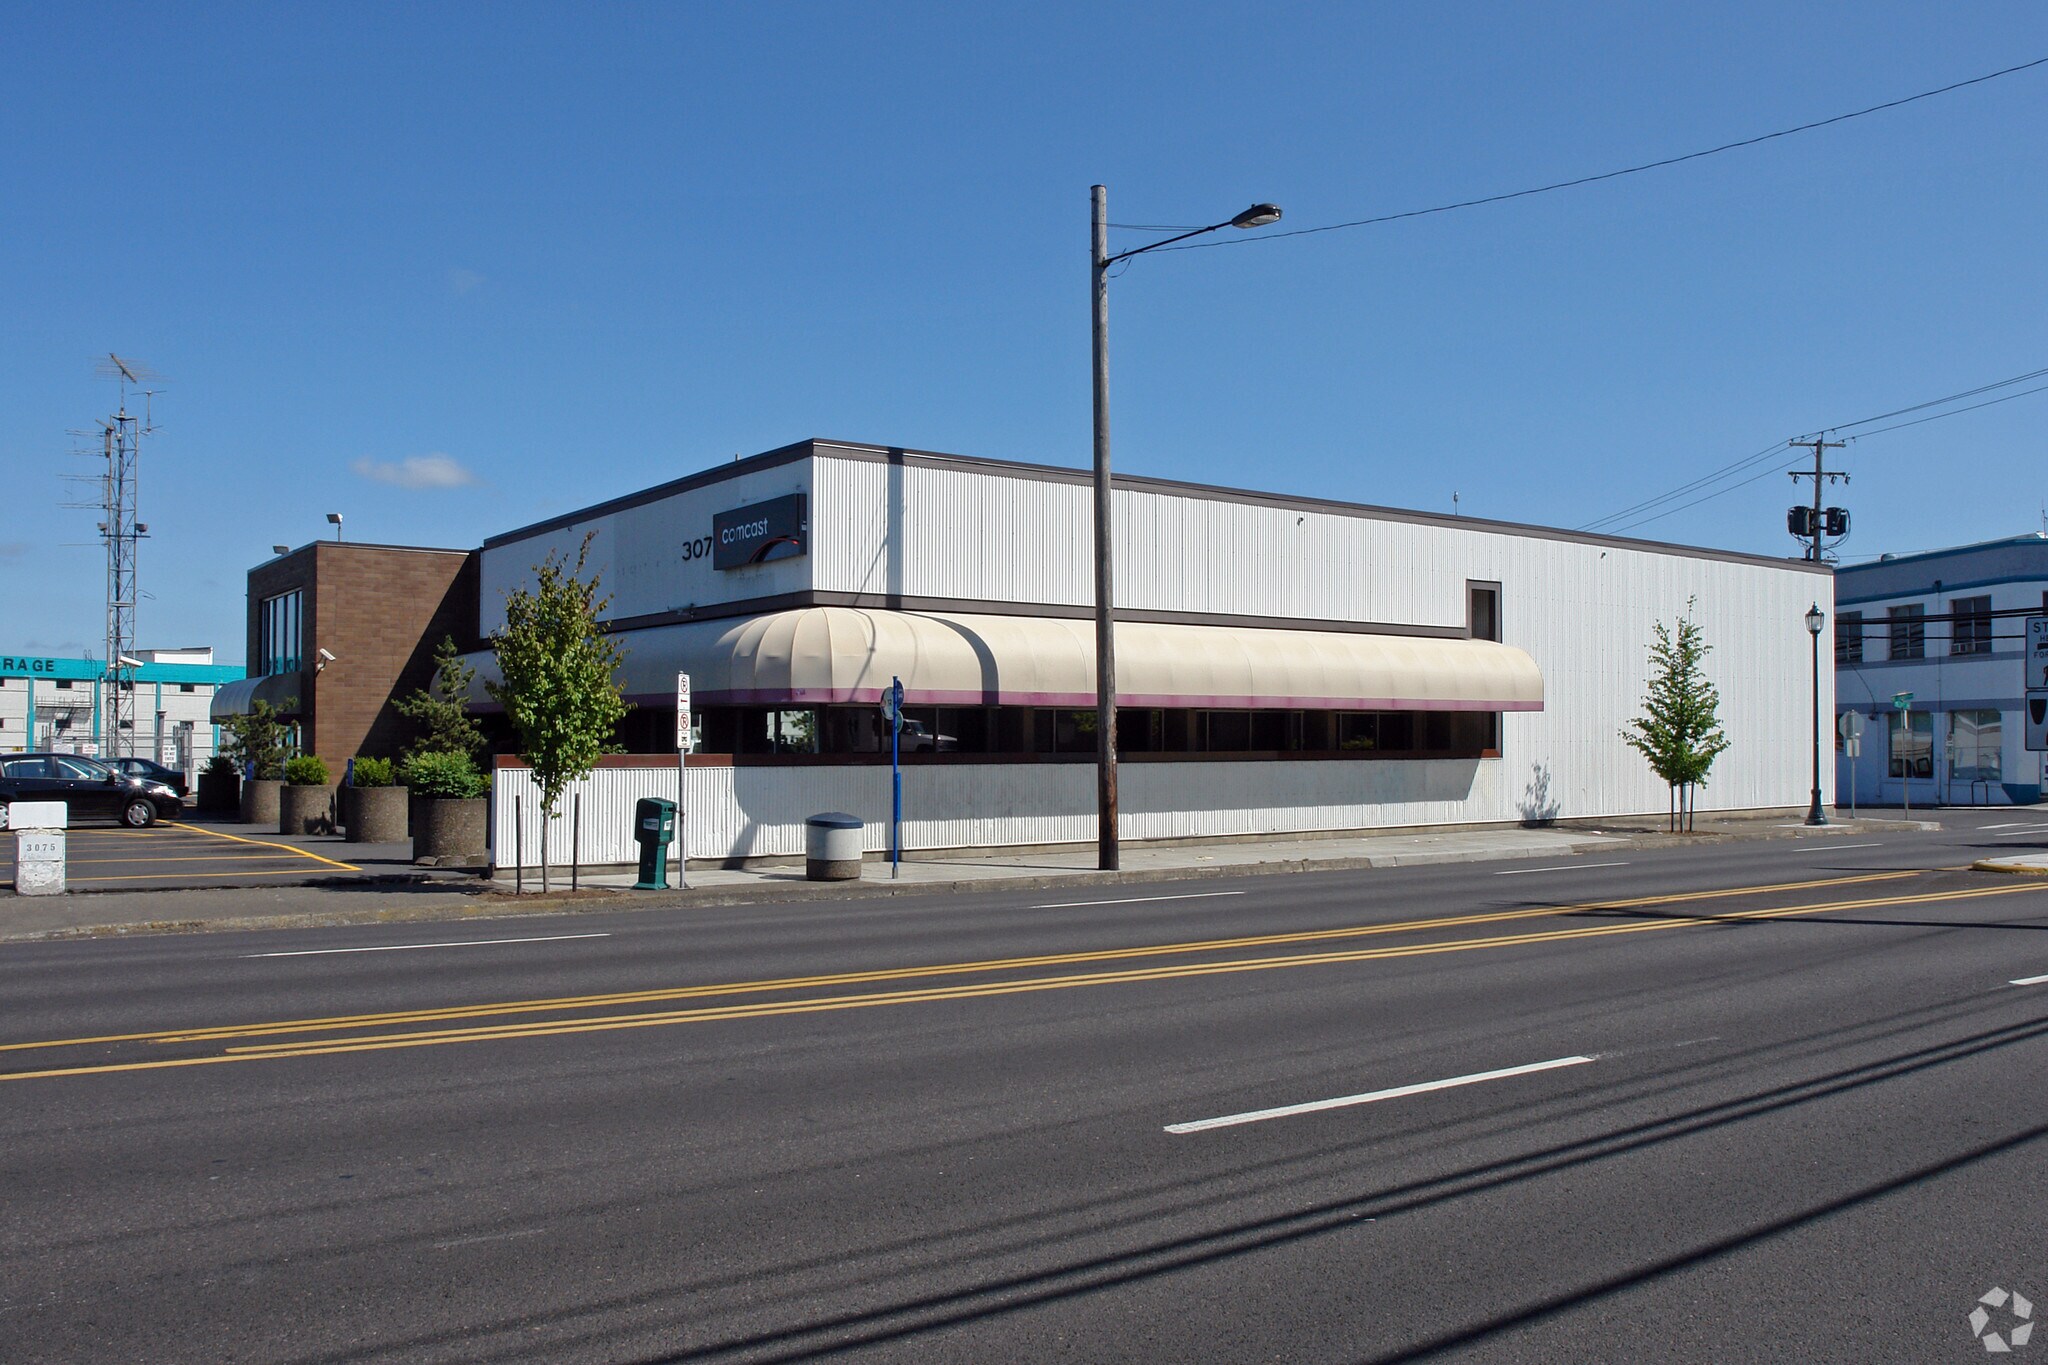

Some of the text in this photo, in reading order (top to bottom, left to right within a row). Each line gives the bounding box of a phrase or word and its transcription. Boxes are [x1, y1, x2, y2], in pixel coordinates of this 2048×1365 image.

[721, 517, 769, 544] comcast
[681, 536, 713, 561] 307
[3, 658, 55, 672] RAGE
[26, 843, 56, 852] 3075
